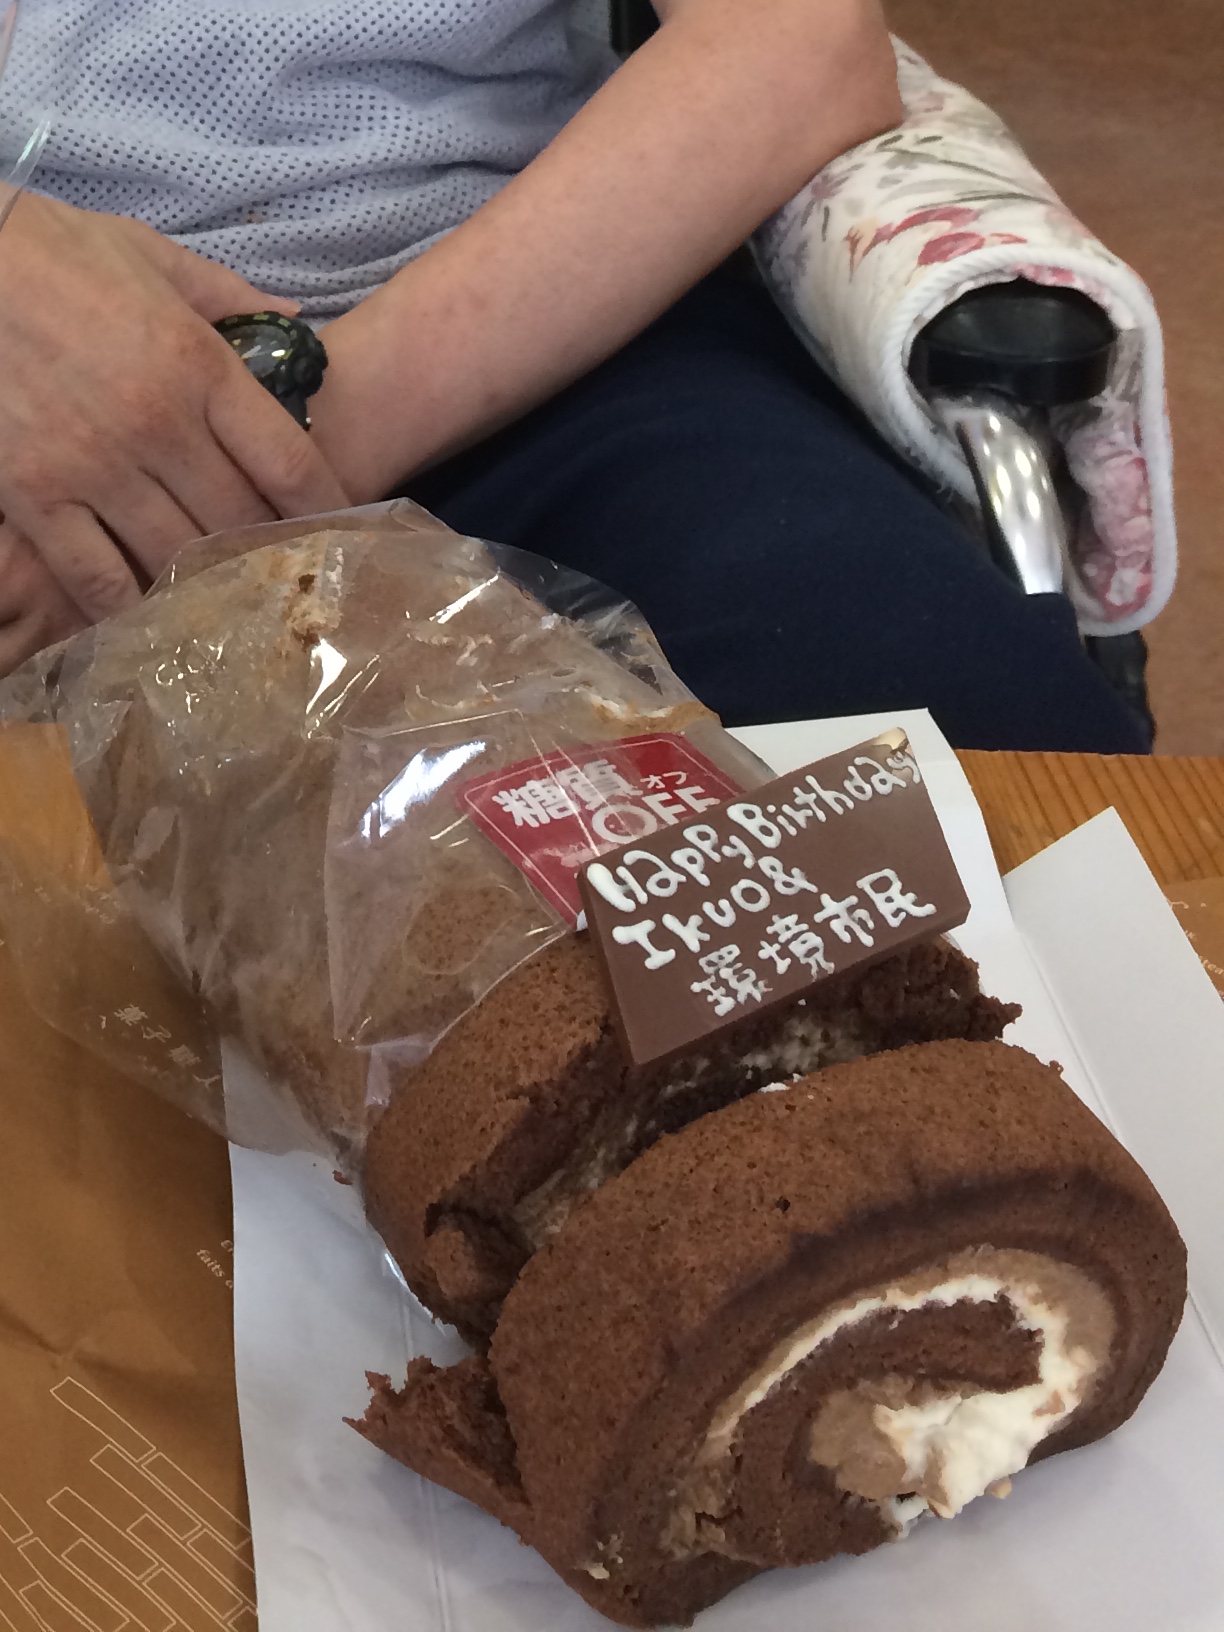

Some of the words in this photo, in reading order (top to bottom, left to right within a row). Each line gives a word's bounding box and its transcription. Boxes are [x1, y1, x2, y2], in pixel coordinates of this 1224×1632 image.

[491, 758, 644, 828] 糖質
[639, 770, 689, 790] オフ
[590, 785, 721, 845] OFF
